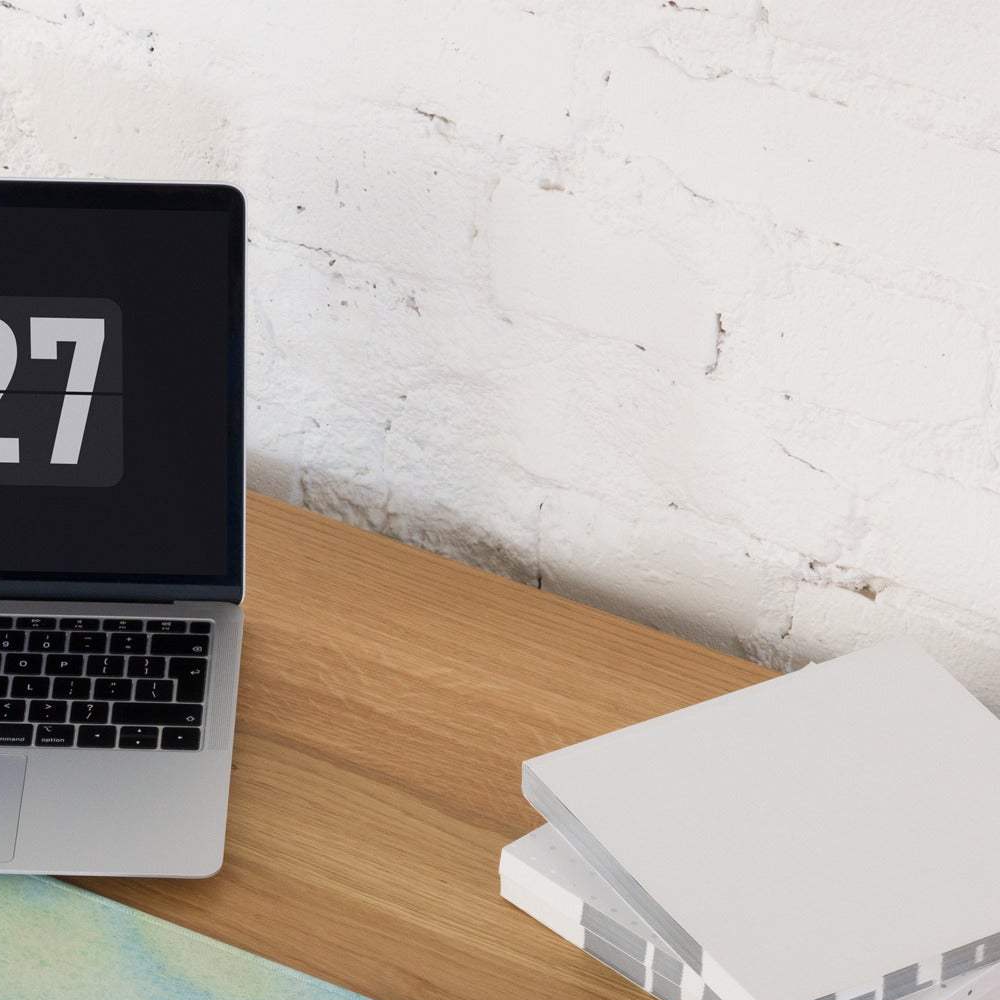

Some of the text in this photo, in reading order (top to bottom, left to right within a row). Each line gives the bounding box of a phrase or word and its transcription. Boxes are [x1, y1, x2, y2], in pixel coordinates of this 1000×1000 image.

[1, 640, 10, 648] 9
[42, 641, 51, 649] 0
[27, 683, 33, 691] L
